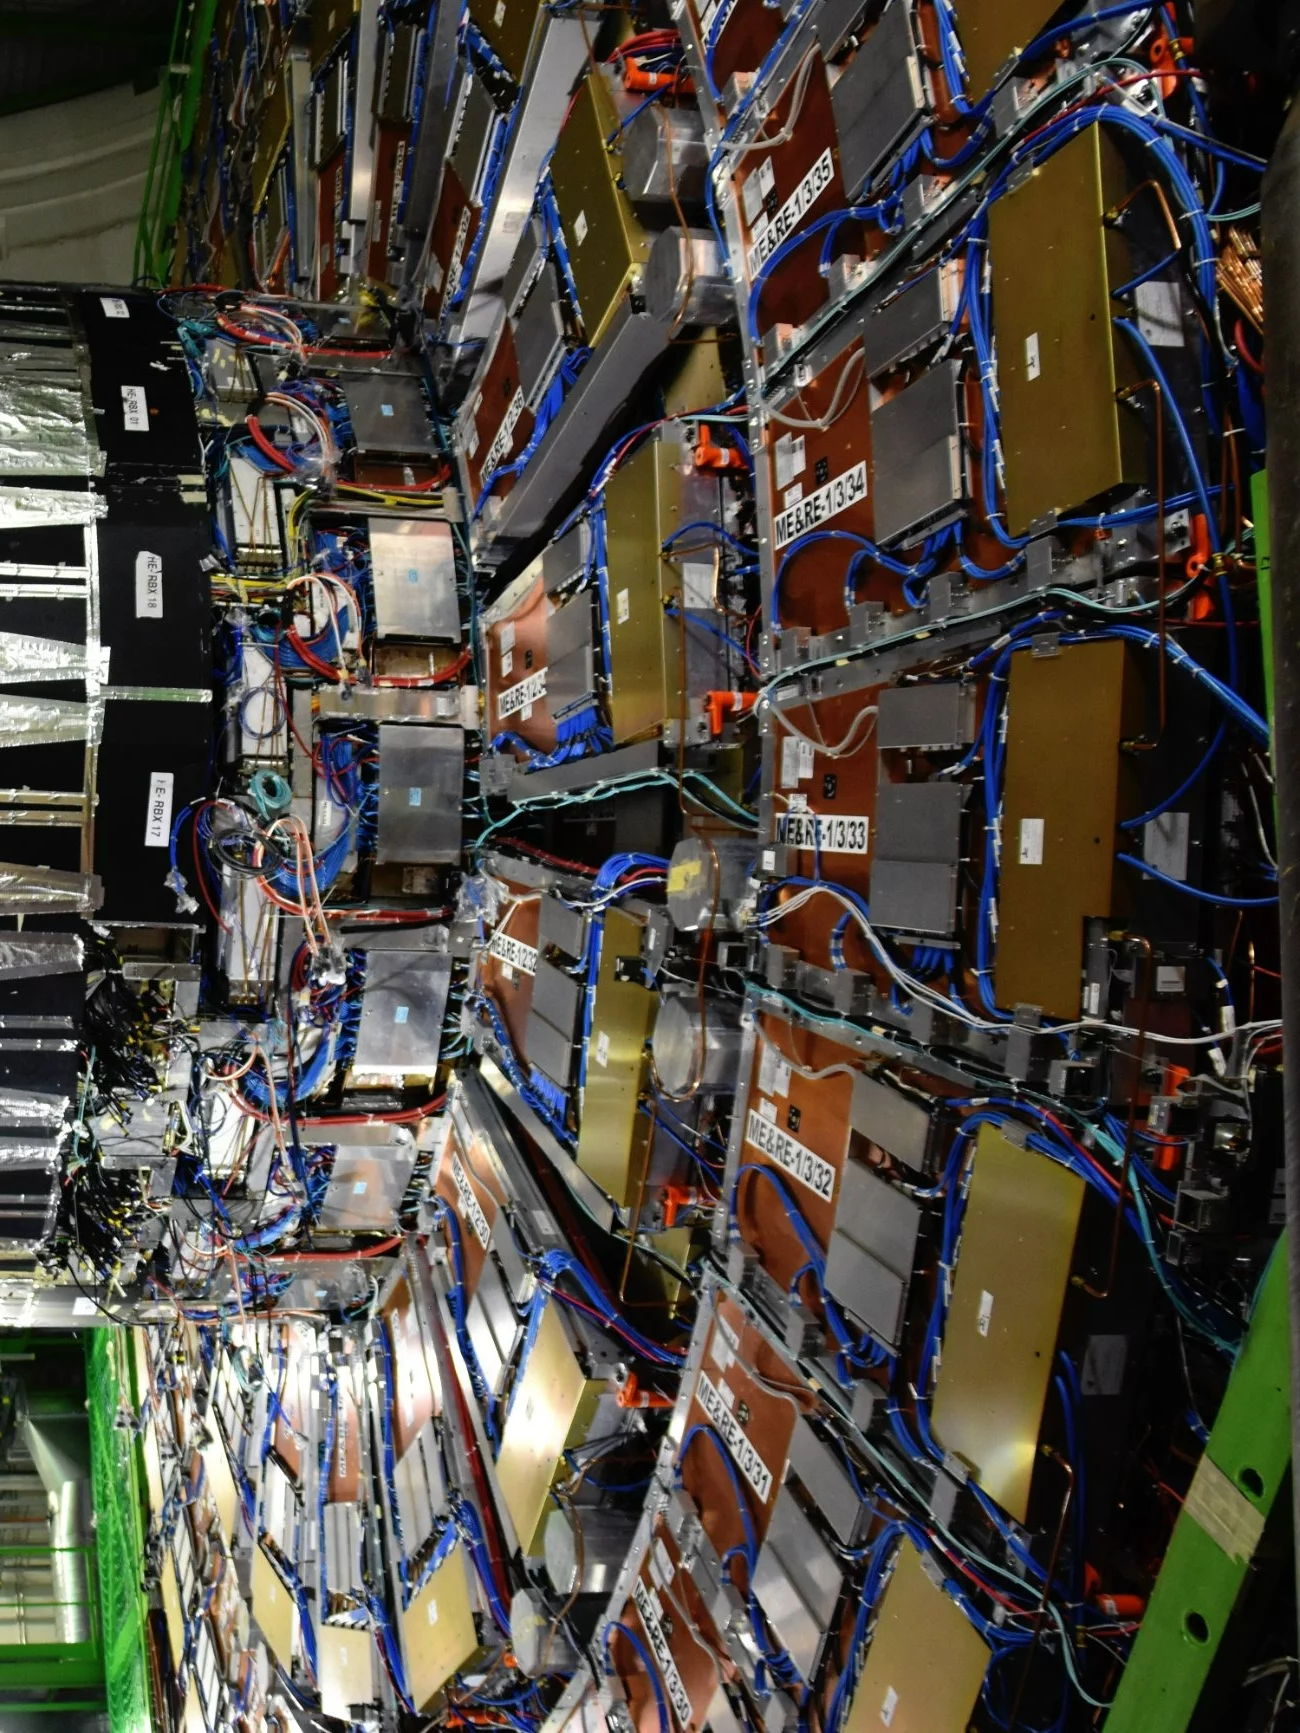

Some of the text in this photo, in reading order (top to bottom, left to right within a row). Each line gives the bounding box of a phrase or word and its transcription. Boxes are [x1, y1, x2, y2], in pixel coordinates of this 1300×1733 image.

[749, 155, 832, 276] ME&RE-1/3/35
[774, 467, 865, 547] ME&RE-1/3/34
[147, 597, 158, 608] 18
[148, 574, 158, 595] RBX
[151, 826, 161, 838] 17
[152, 800, 165, 823] RBX
[748, 1114, 833, 1197] ME&RE-1/3/32
[699, 1375, 769, 1497] ME&RE-1/3/31
[634, 1580, 690, 1723] ME&RE-1/3/30
